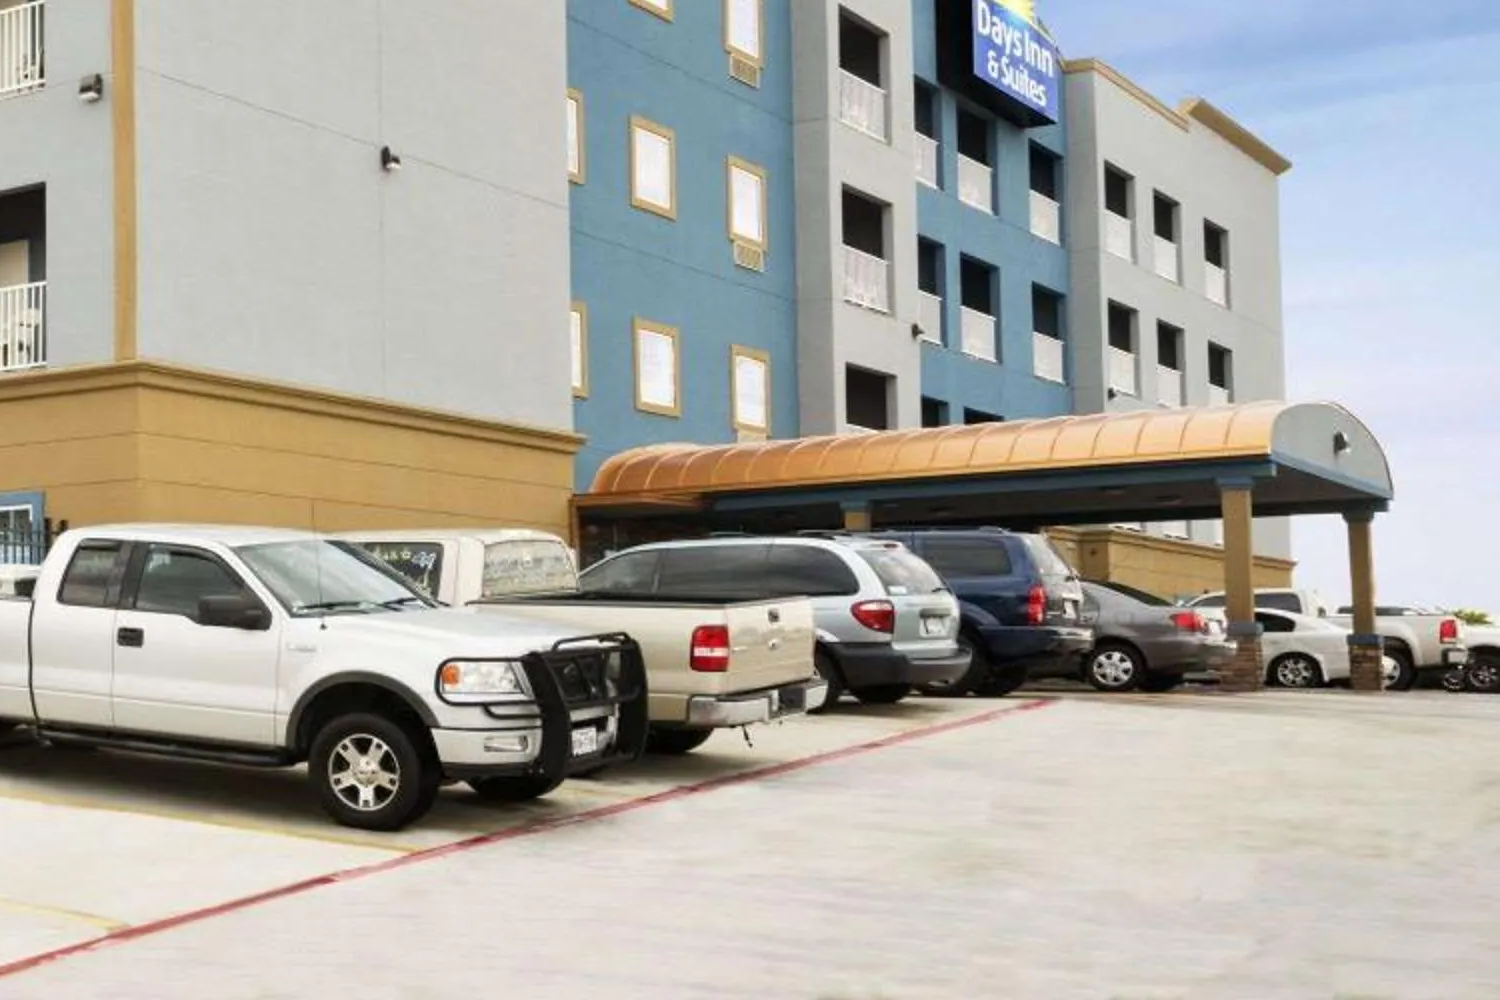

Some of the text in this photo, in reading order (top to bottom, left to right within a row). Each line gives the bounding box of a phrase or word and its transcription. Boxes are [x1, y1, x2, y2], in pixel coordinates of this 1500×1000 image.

[987, 49, 1048, 107] & Suites
[1024, 30, 1055, 78] Inn
